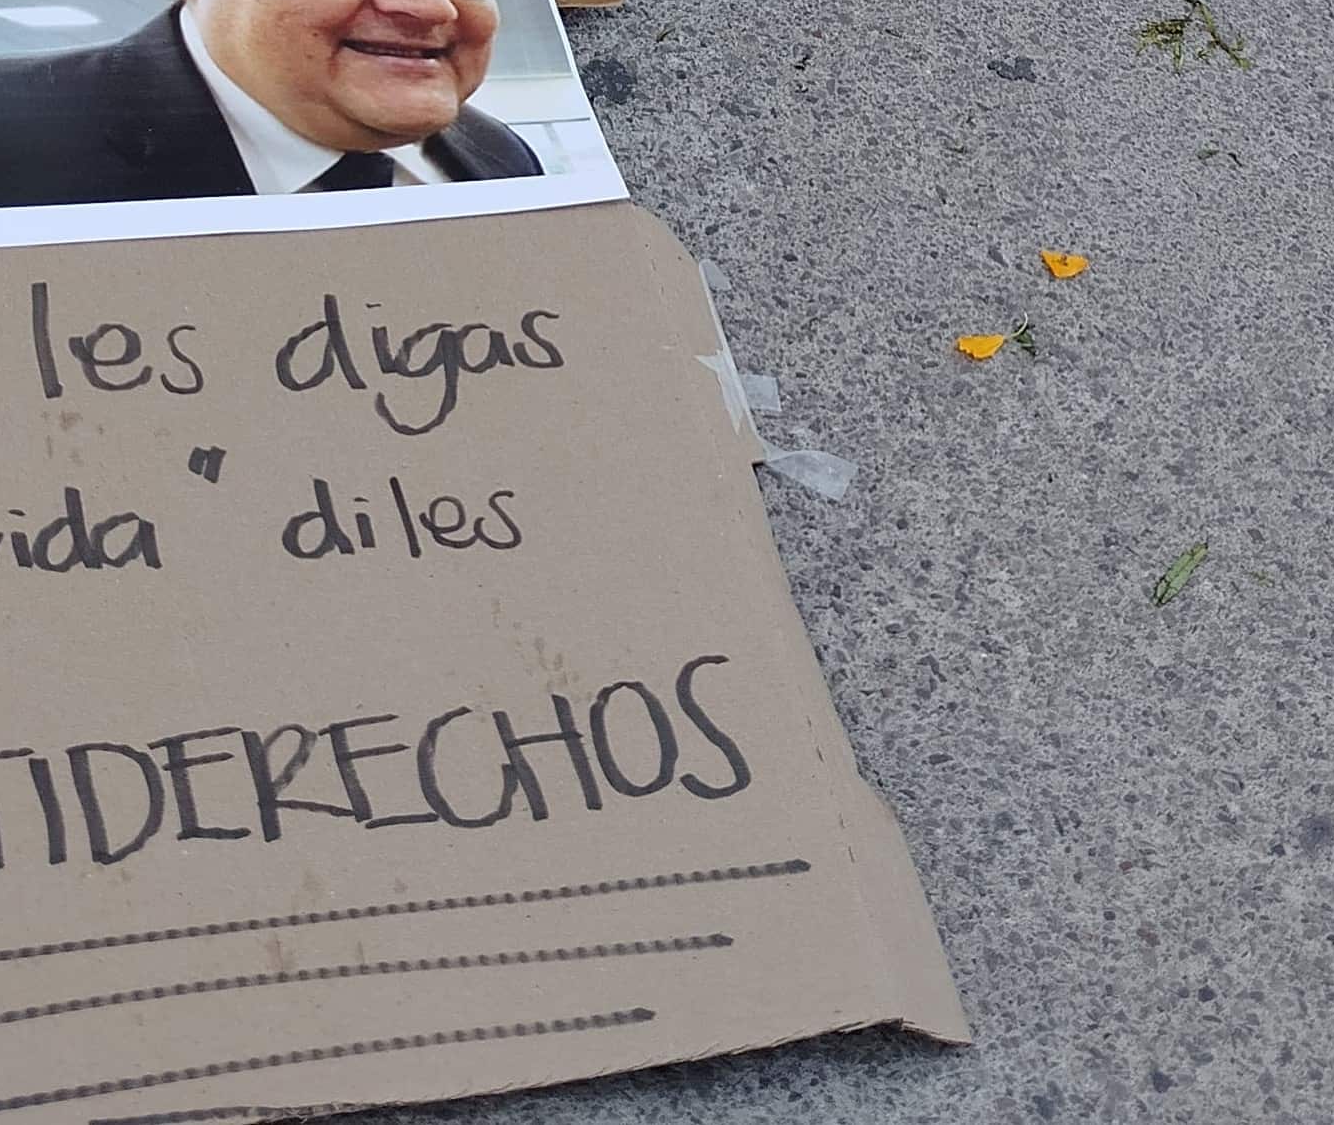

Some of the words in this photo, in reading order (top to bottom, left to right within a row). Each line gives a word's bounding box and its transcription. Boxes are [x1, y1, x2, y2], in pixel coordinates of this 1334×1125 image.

[31, 282, 206, 400] les
[274, 293, 567, 437] digas
[281, 477, 524, 560] diles
